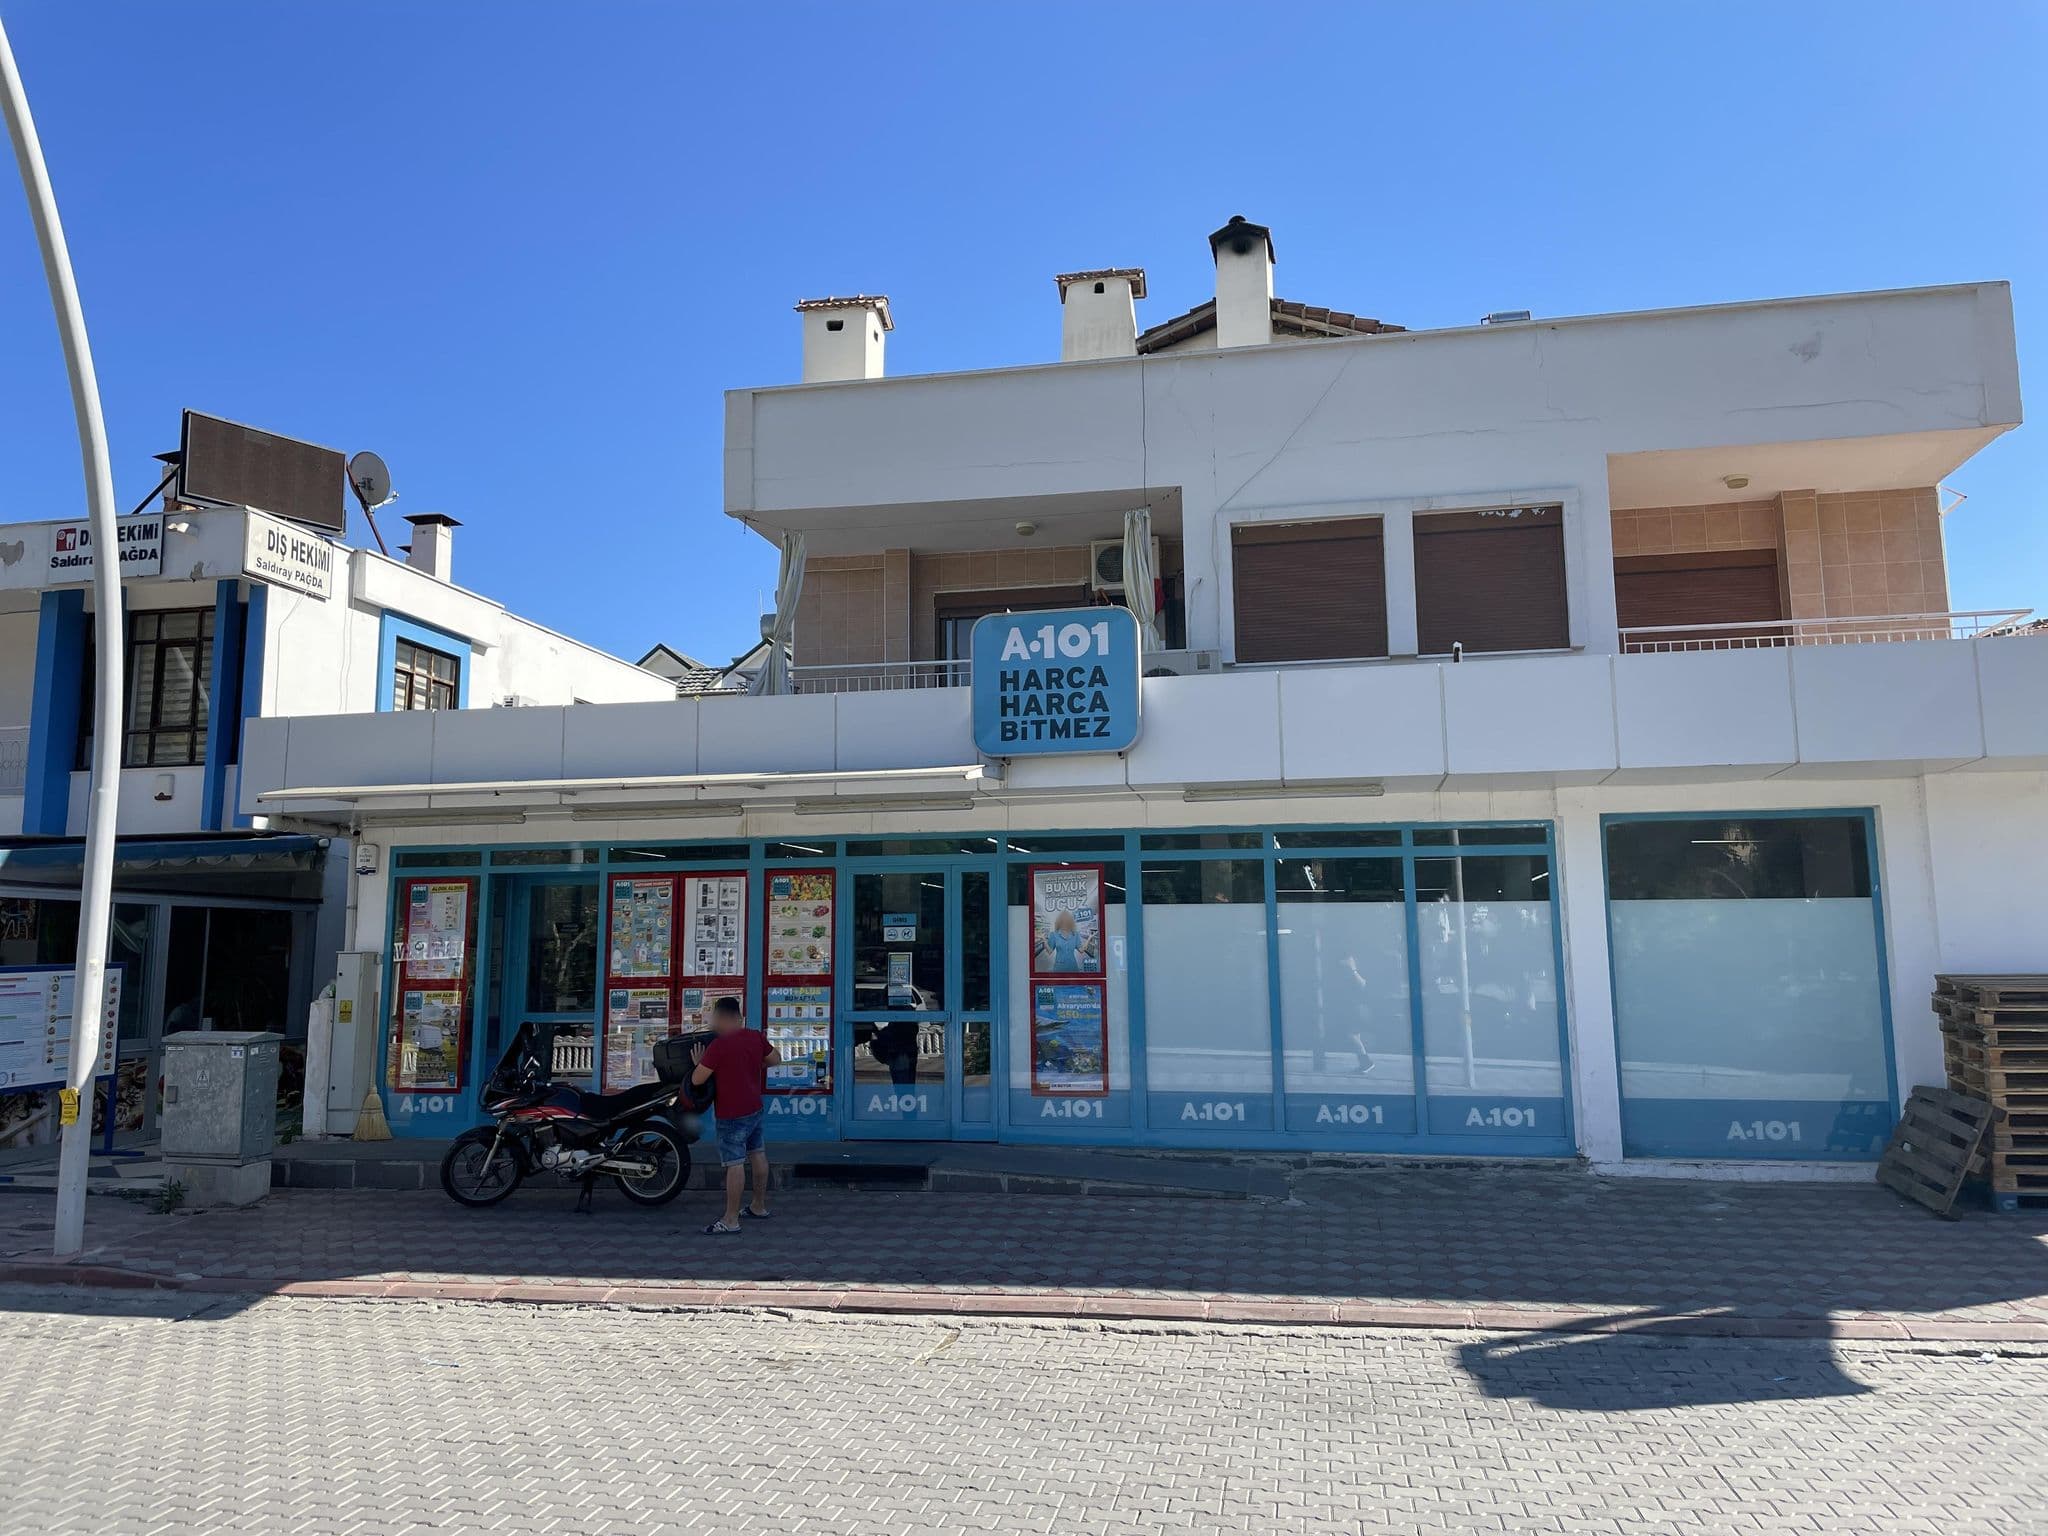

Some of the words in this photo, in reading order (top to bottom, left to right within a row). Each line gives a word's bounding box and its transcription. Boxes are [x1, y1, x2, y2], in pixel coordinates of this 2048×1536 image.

[119, 546, 158, 562] AĞDA
[267, 527, 287, 562] DİŞ
[291, 537, 330, 573] HEKİMİ
[256, 557, 293, 581] Saldıray
[295, 570, 323, 589] PAĞDA
[1000, 665, 1109, 692] HARCA
[1000, 690, 1109, 717] HARCA
